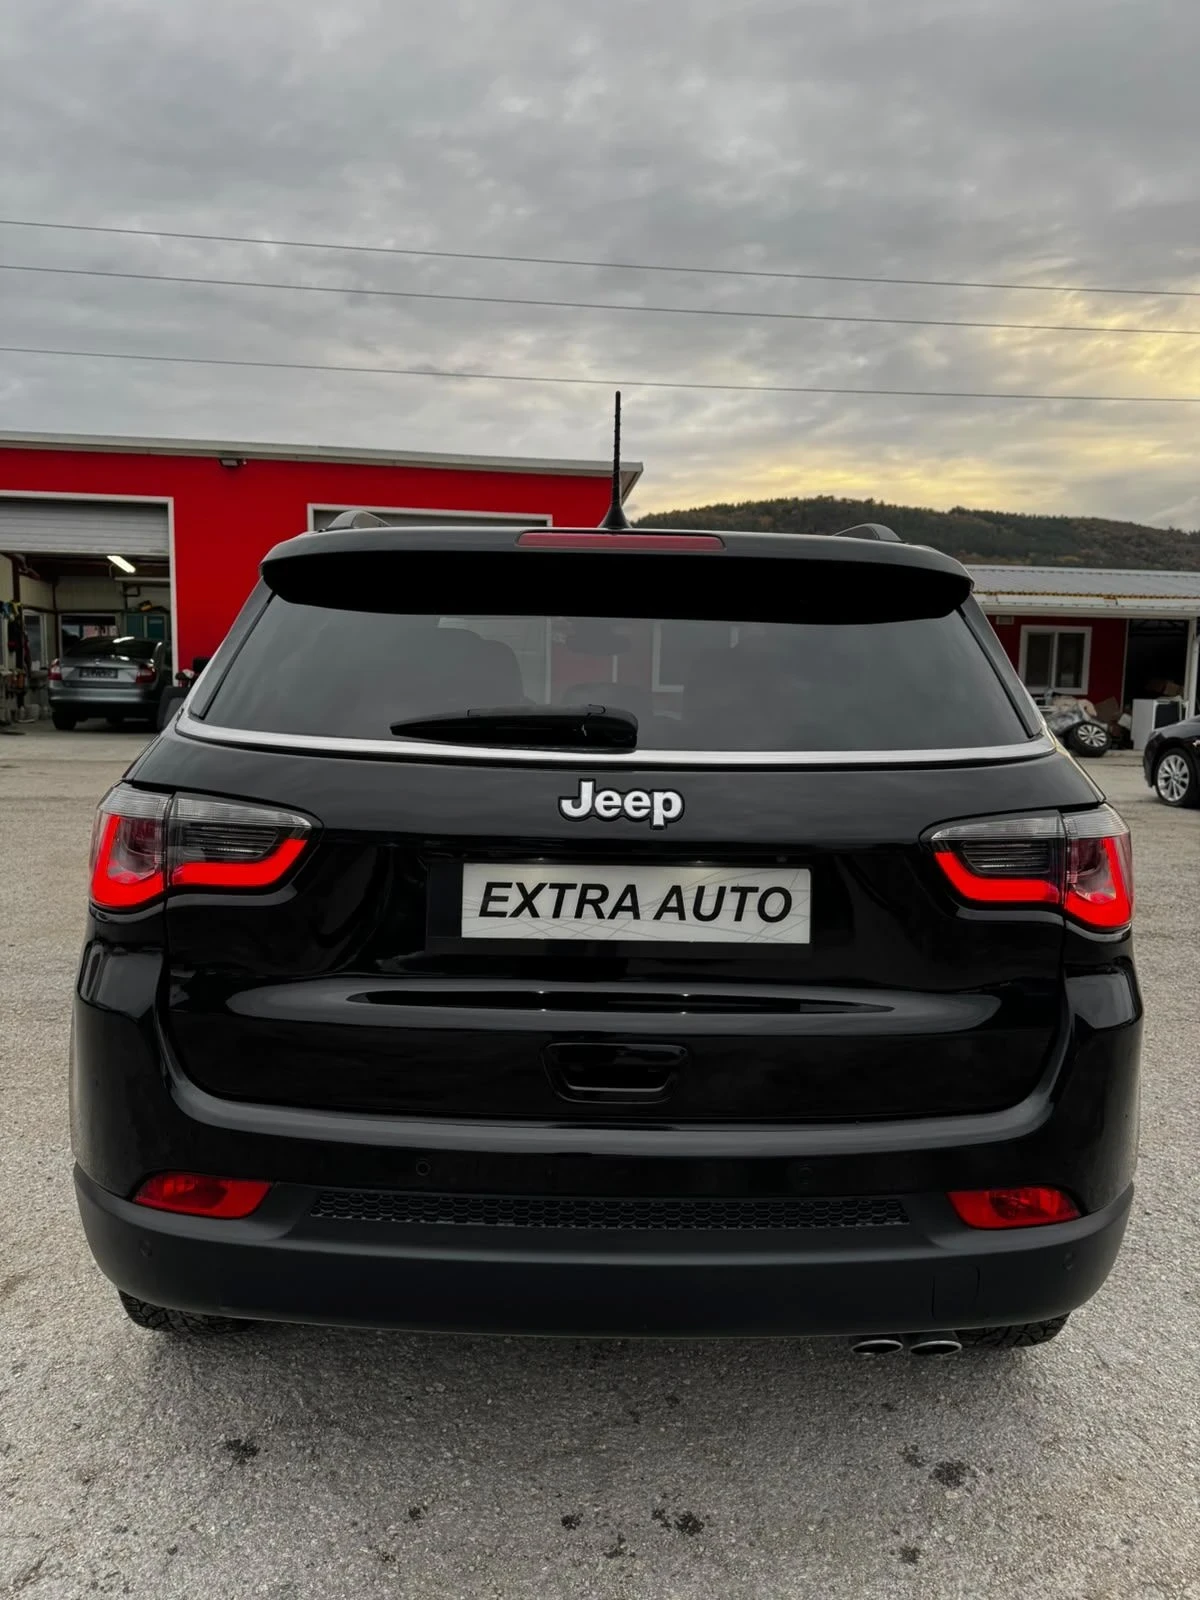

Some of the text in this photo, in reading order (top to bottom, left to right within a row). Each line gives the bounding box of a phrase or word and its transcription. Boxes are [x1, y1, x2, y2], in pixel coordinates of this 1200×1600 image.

[560, 780, 684, 827] Jeep
[478, 881, 793, 923] EXTRA AUTO
